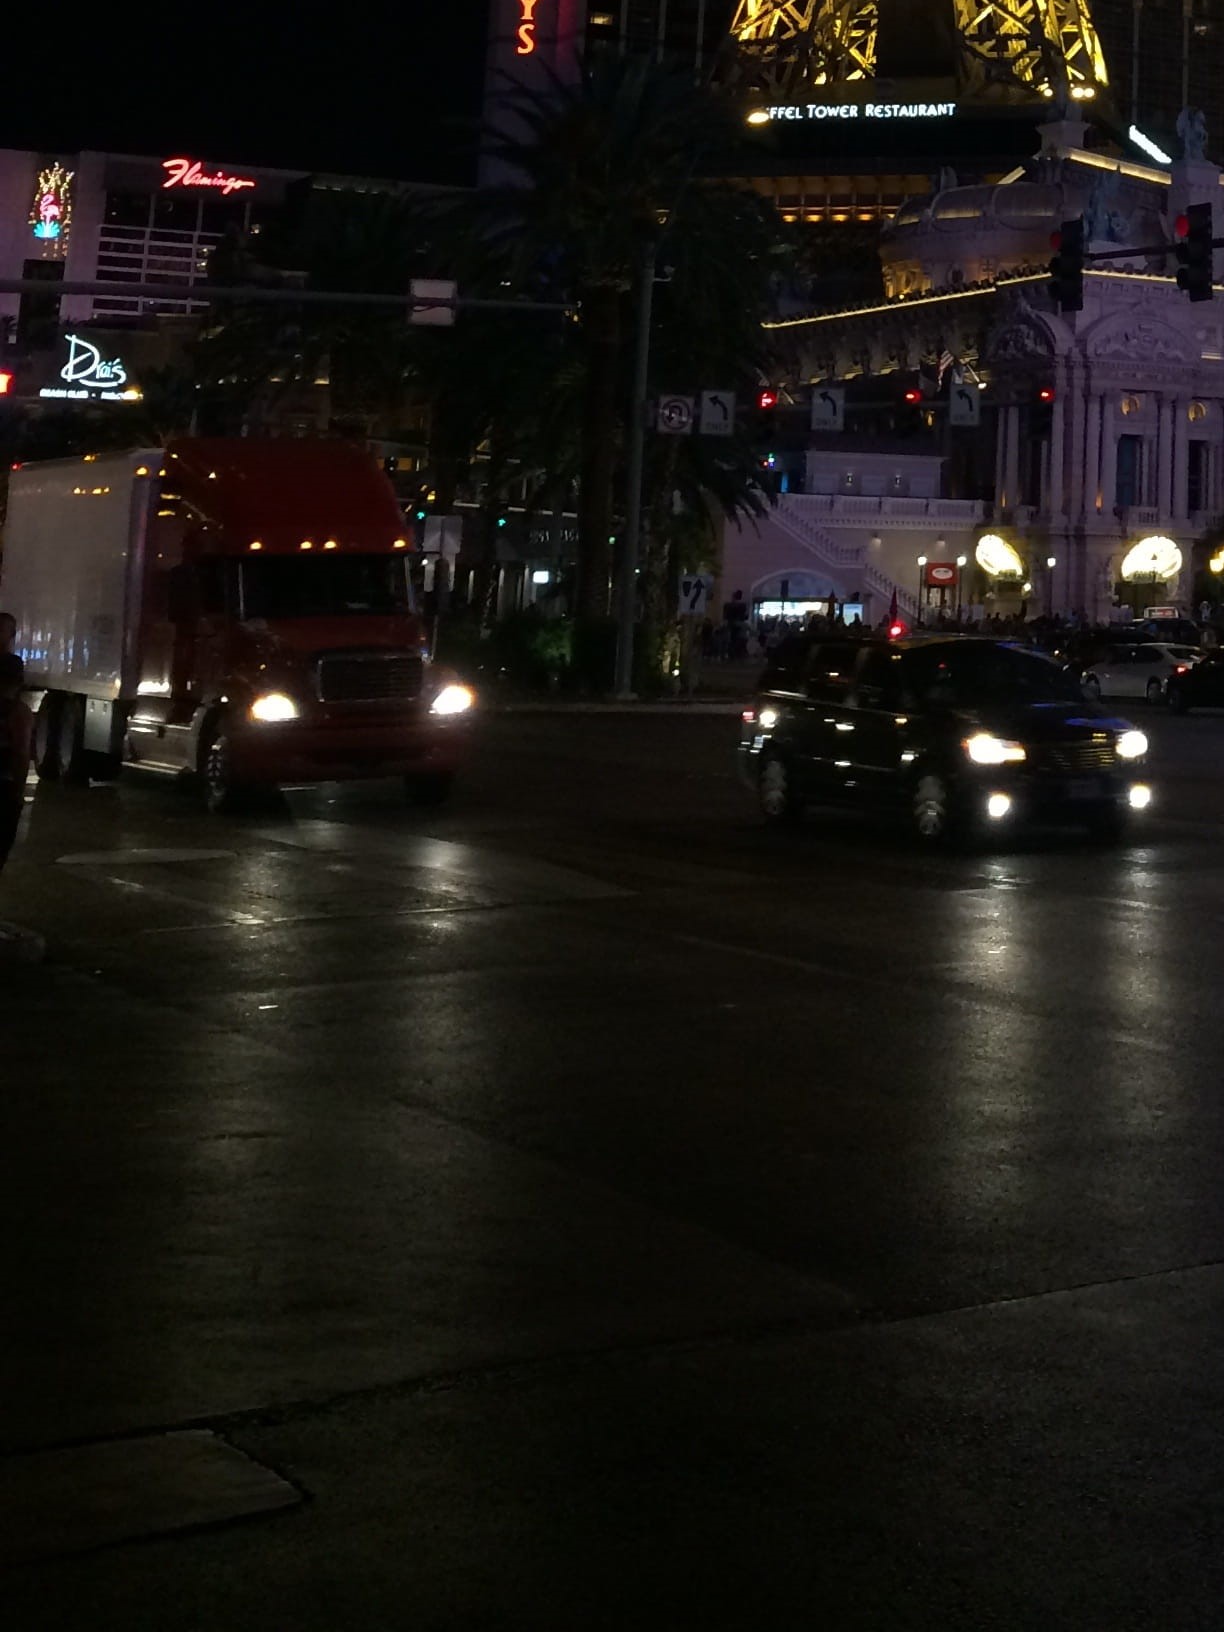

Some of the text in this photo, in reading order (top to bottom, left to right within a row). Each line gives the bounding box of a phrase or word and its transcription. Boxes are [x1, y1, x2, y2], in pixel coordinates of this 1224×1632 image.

[763, 102, 956, 120] FFEL TOWER RESTAURANT
[160, 158, 256, 195] Flamingo
